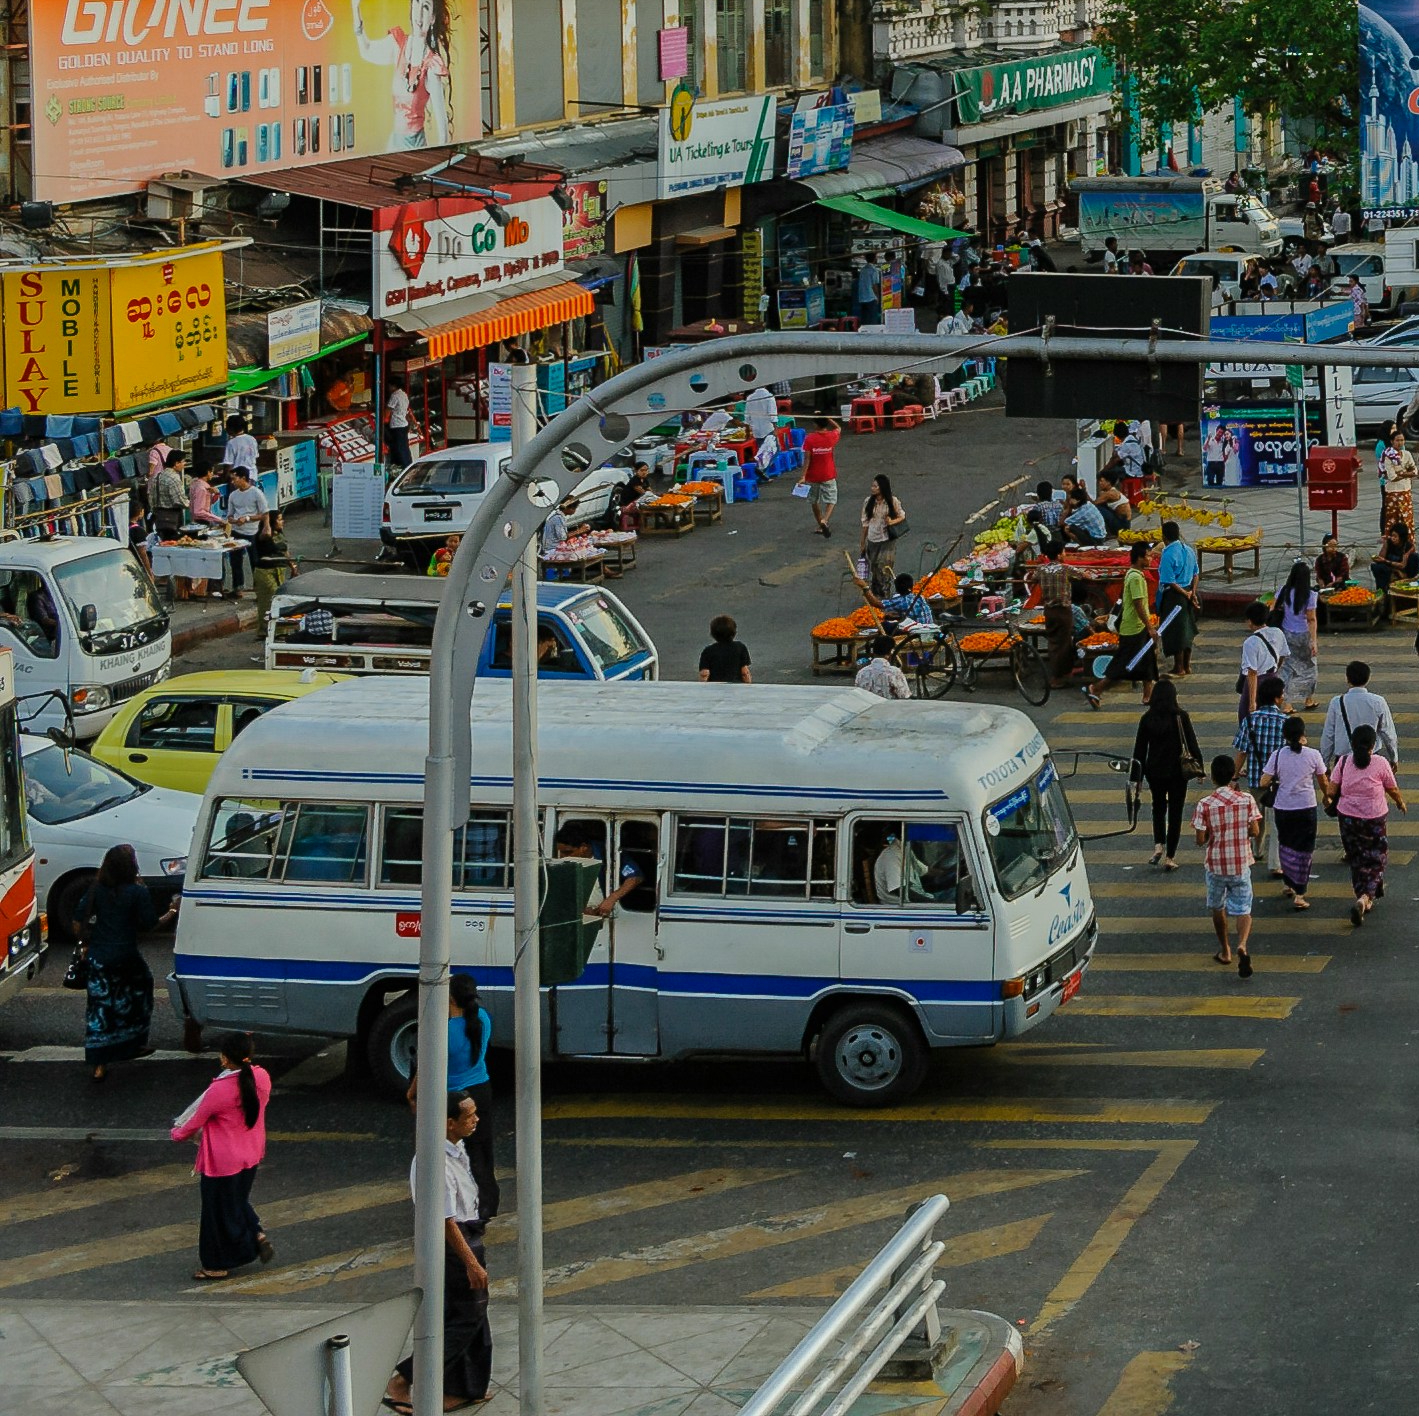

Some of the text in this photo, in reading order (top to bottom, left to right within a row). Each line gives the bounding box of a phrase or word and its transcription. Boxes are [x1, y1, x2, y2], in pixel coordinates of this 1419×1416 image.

[58, 38, 275, 70] GOLDEN QUALITY TO STAND LONG
[1025, 56, 1097, 100] PHARMACY
[68, 97, 96, 115] STRONG
[98, 94, 125, 112] SOURCE
[669, 146, 683, 164] UA
[685, 140, 723, 162] Ticketing
[731, 138, 754, 153] Tours
[471, 222, 497, 255] Co
[503, 216, 529, 248] Mo
[17, 272, 49, 413] SULAY
[61, 278, 81, 398] MOBILE
[1219, 362, 1272, 373] FLUZA
[100, 640, 166, 671] KHAING KHAING
[119, 631, 148, 649] JAC
[977, 758, 1020, 790] TOYOTA
